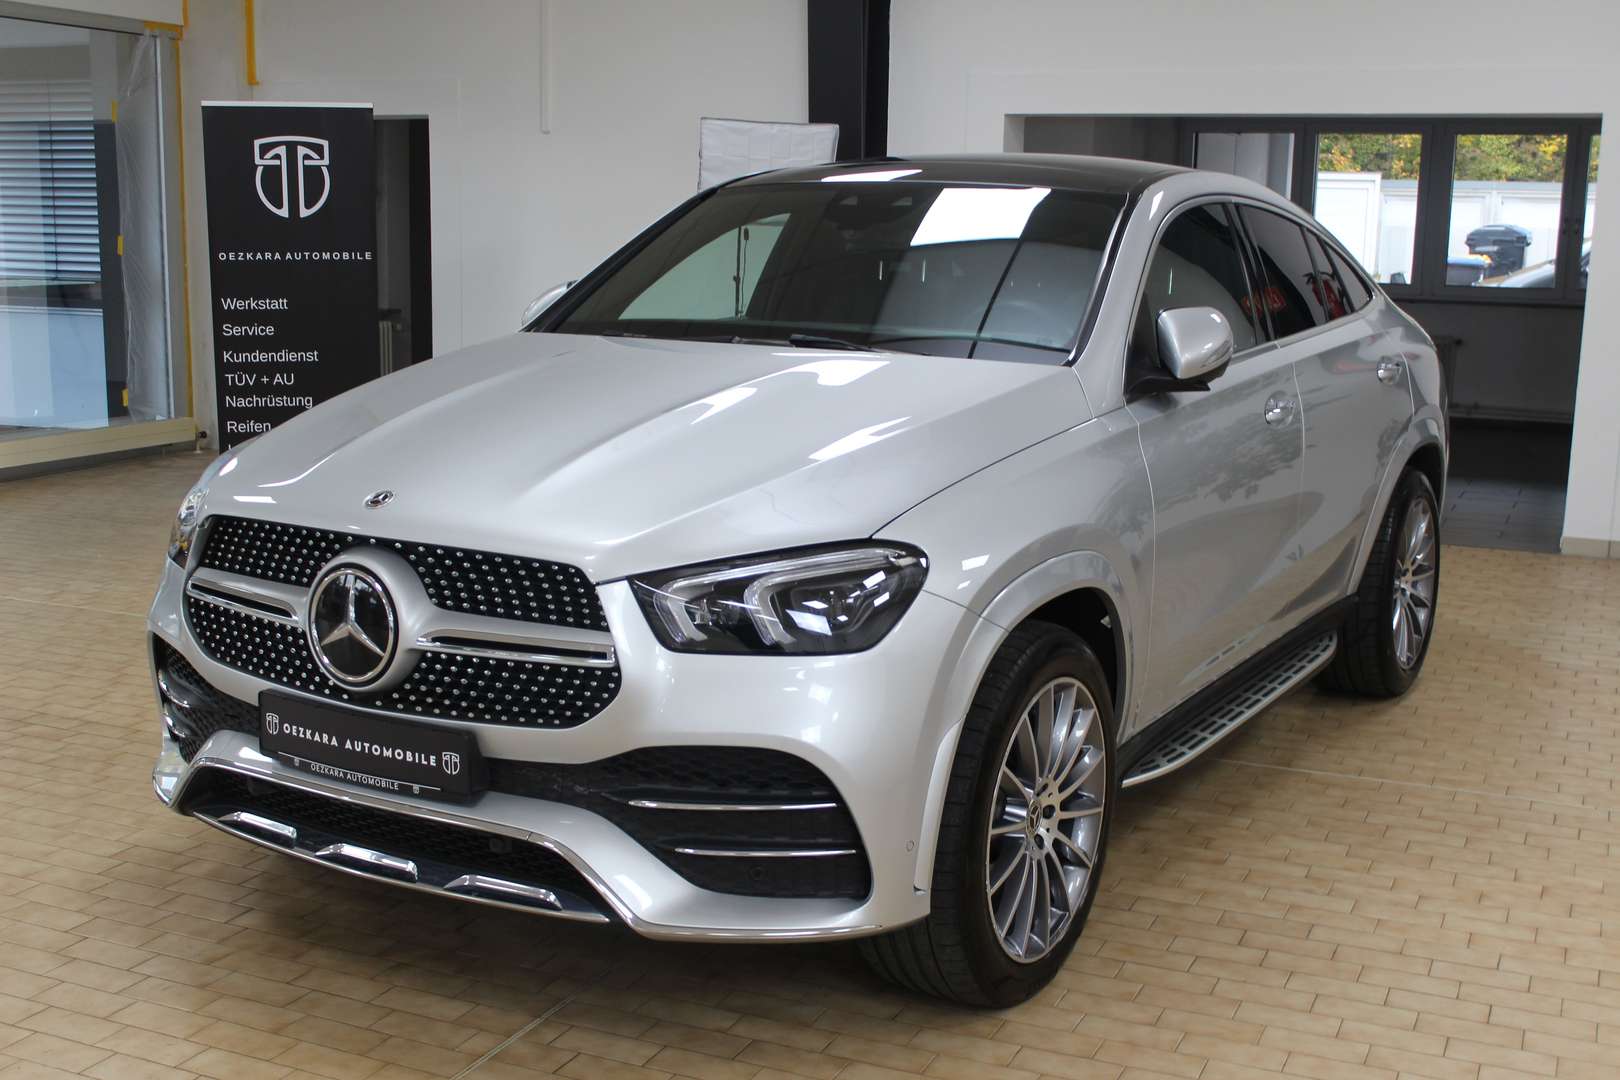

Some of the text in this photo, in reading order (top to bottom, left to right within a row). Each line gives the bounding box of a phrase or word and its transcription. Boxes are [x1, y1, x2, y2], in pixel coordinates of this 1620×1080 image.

[218, 251, 373, 260] OEZKARA AUTOMOBILE
[221, 298, 288, 310] Werkstatt
[222, 324, 275, 336] Service
[223, 350, 319, 363] Kundendienst
[225, 372, 295, 386] TÜV + AU
[225, 395, 313, 409] Nachrüstung
[227, 421, 271, 433] Reifen
[283, 723, 437, 766] OEZKARA AUTOMOBILE
[311, 763, 399, 790] OEZKARA AUTOMOBILE
